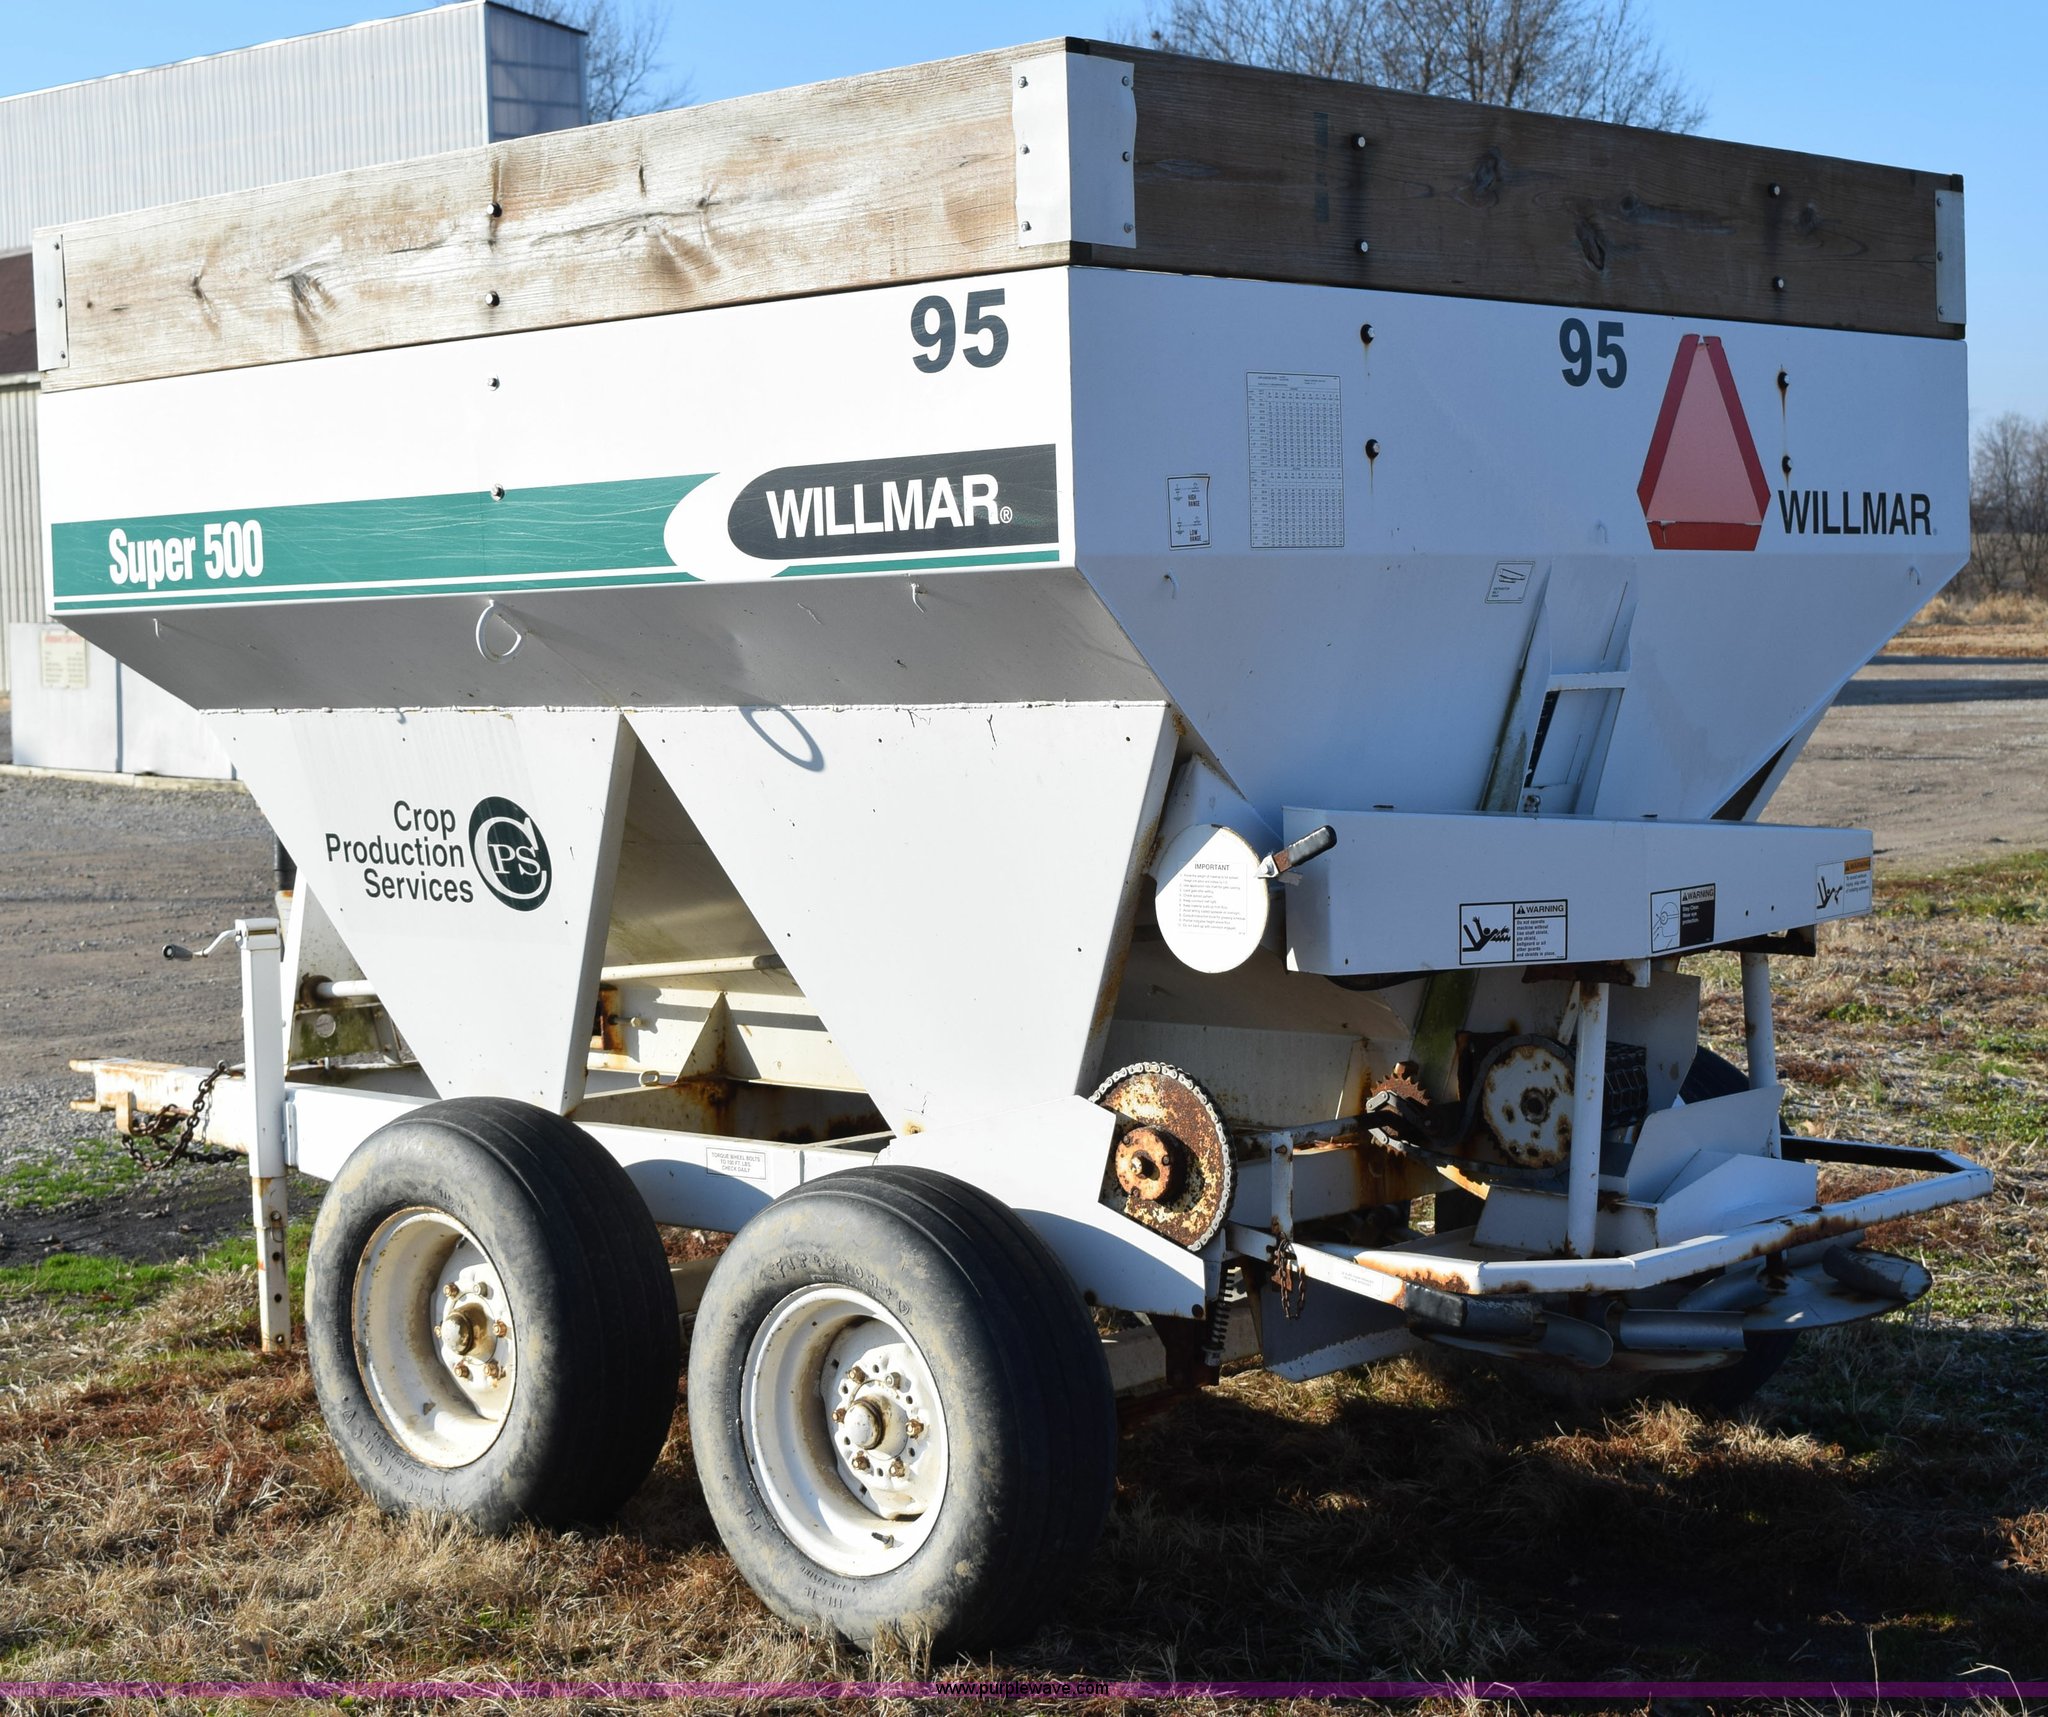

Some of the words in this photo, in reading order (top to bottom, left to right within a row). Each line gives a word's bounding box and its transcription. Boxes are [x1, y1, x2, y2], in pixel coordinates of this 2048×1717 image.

[910, 288, 1009, 373] 95
[1559, 317, 1628, 389] 95
[1778, 490, 1932, 536] WILLMAR
[108, 528, 196, 590] Super
[203, 519, 264, 580] 500
[394, 800, 456, 840] Crop
[325, 833, 465, 868] Production
[1194, 863, 1230, 871] IMPORTANT
[363, 868, 474, 903] Services
[1687, 889, 1714, 900] WARNING
[1526, 905, 1564, 913] WARNING
